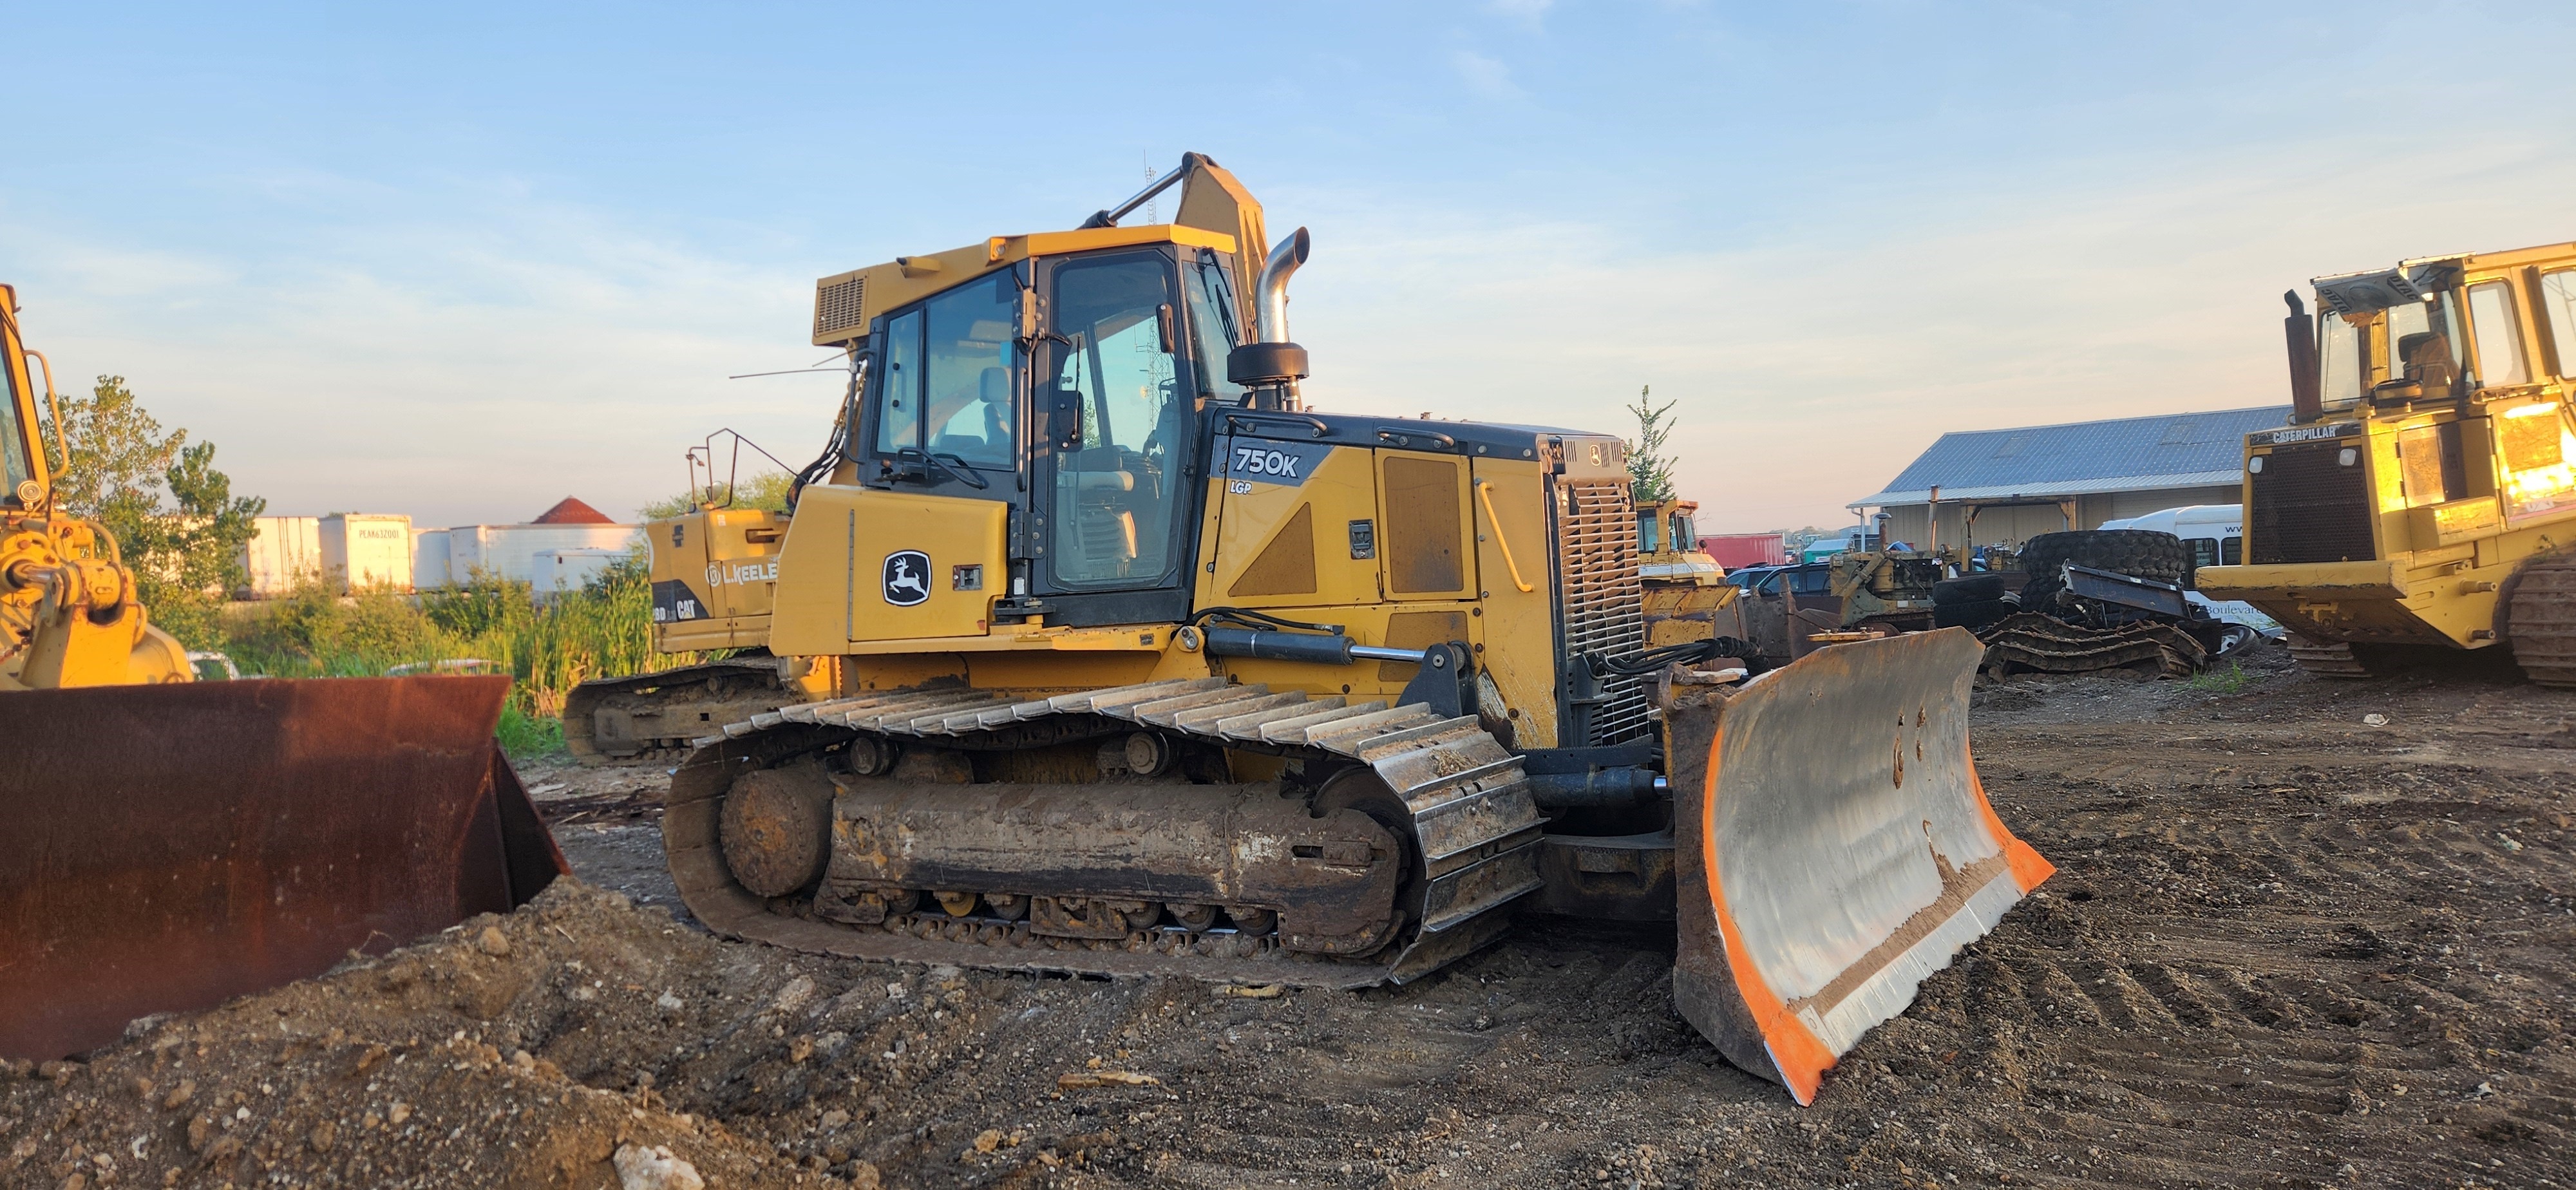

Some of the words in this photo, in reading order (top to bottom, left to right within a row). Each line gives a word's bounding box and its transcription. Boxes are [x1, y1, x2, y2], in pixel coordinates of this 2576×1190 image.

[2273, 426, 2337, 443] CATERPILLAR
[1235, 448, 1300, 478] 750K
[1230, 481, 1252, 495] LGP
[677, 600, 695, 619] CAT
